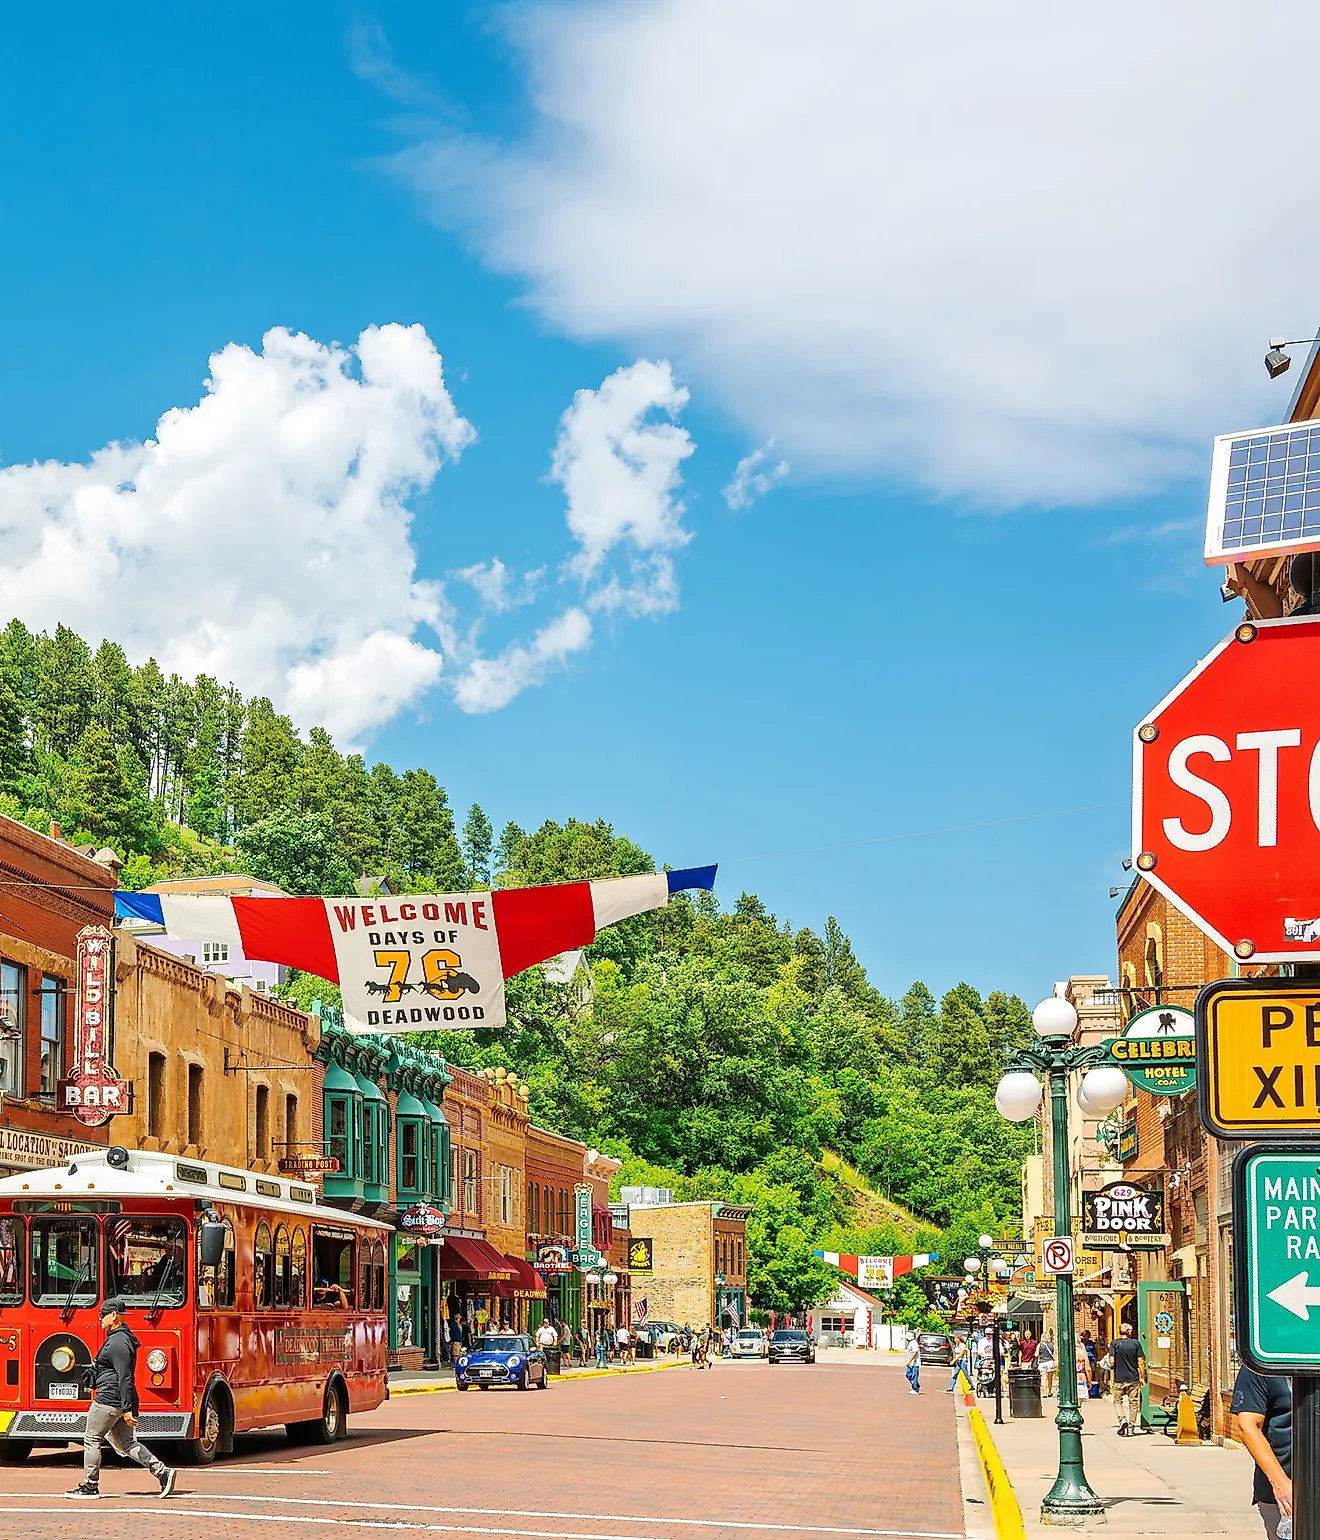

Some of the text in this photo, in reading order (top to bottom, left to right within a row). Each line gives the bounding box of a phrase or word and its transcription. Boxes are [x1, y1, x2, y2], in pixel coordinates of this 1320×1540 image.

[1162, 729, 1320, 852] ST
[333, 900, 489, 933] WELCOME
[368, 929, 458, 946] DAYS OF
[373, 949, 465, 1003] 76
[84, 939, 103, 1075] WILD BILL
[366, 1006, 485, 1026] DEADWOOD
[1144, 1066, 1188, 1079] HOTEL
[65, 1085, 120, 1106] BAR
[1252, 1065, 1320, 1109] XI
[6, 1132, 52, 1156] LOCATION
[14, 1153, 26, 1162] SPOT
[36, 1156, 45, 1165] THE
[46, 1157, 56, 1166] OLD
[284, 1160, 333, 1169] TRADING POST
[1113, 1188, 1132, 1197] 629
[1093, 1196, 1153, 1219] PINK
[580, 1198, 589, 1249] EAGLE
[1096, 1217, 1153, 1231] DOOR
[1266, 1206, 1317, 1230] PAR
[1084, 1235, 1117, 1243] BOUTIQUE
[1287, 1235, 1320, 1260] RA
[572, 1254, 596, 1263] BAR
[860, 1257, 892, 1266] WELCOME
[1075, 1256, 1097, 1265] ORSE
[8, 1335, 17, 1351] 5
